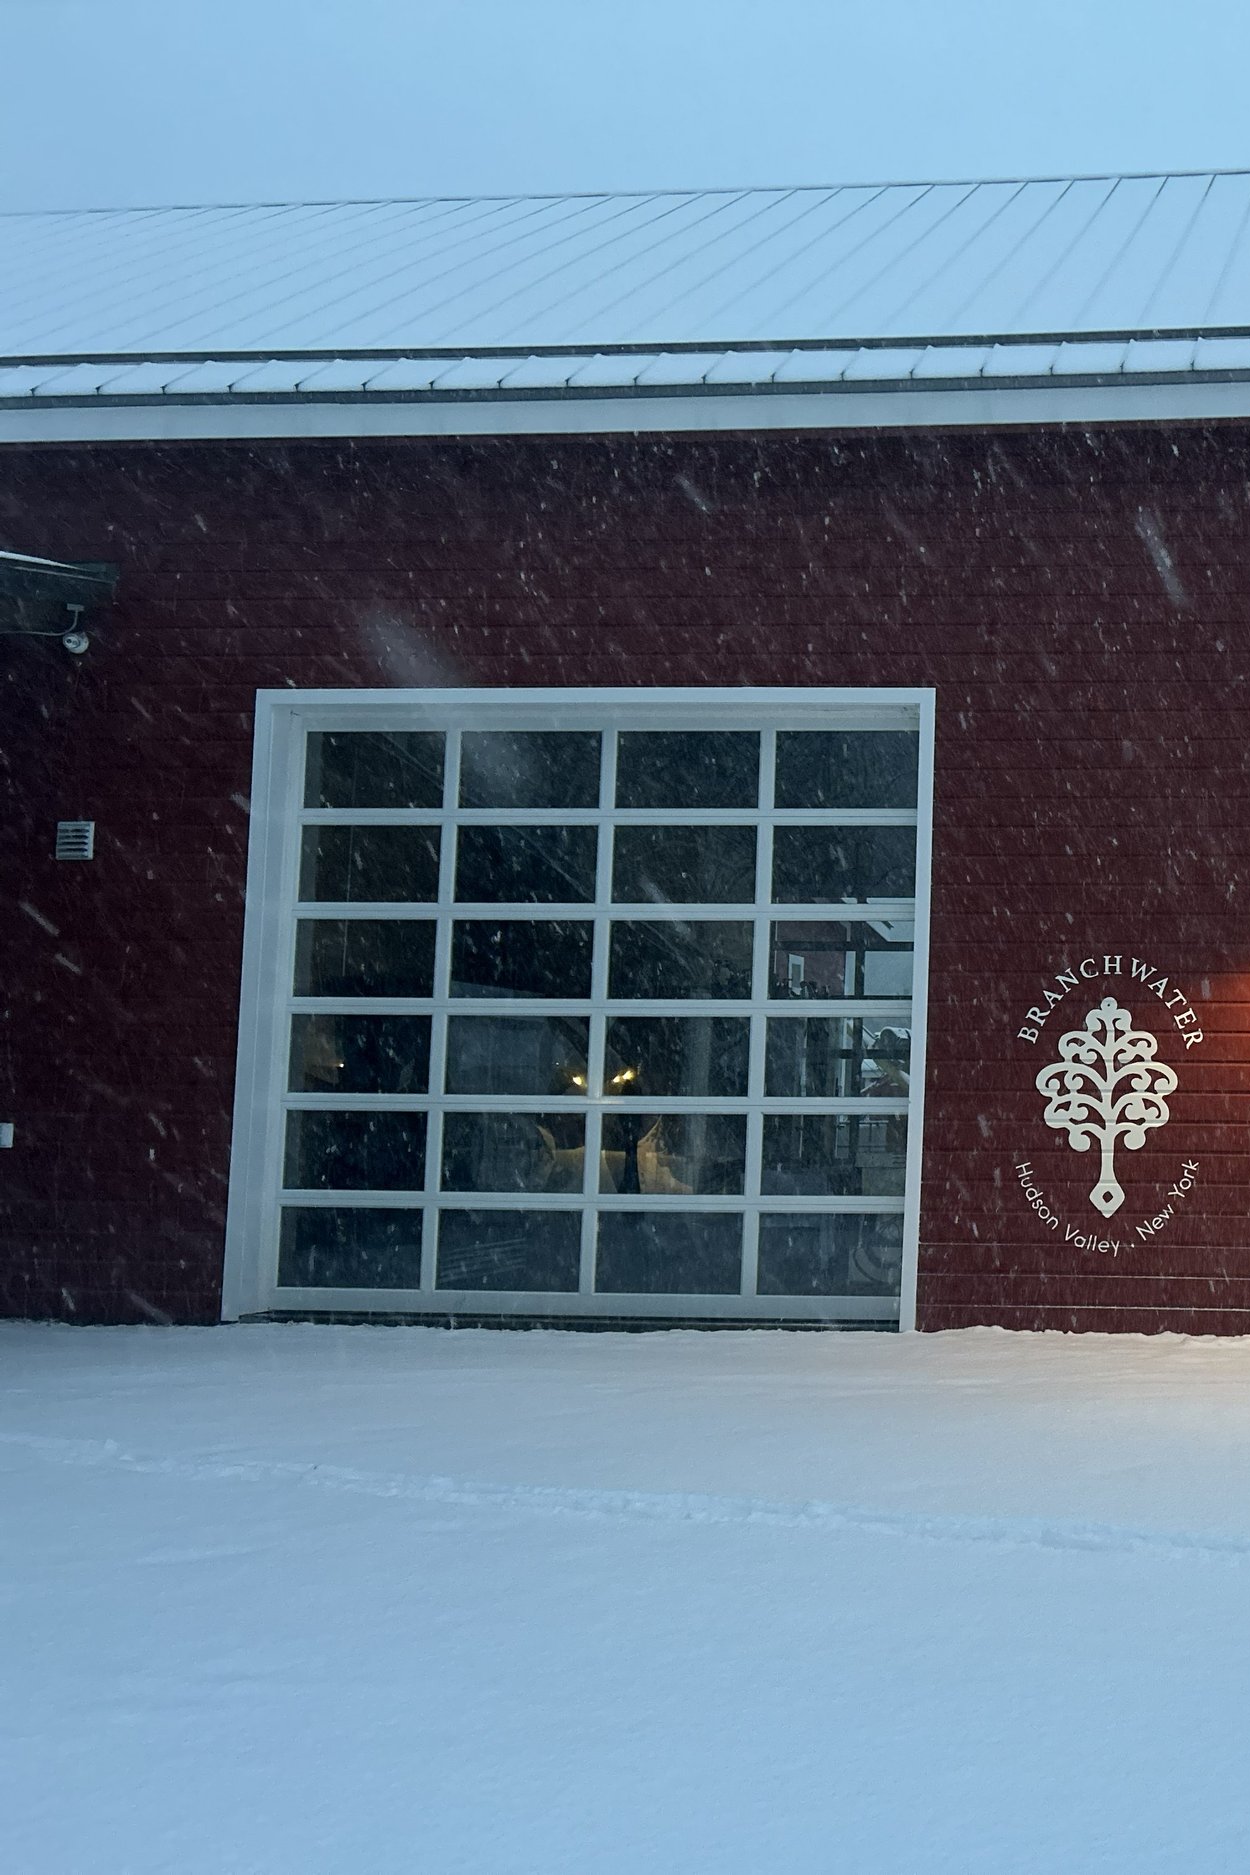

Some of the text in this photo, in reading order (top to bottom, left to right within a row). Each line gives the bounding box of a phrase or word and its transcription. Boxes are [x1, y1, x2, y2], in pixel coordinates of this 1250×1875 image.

[1017, 955, 1204, 1050] BRANCHWATER
[1015, 1159, 1199, 1258] Hudson Valley New York
